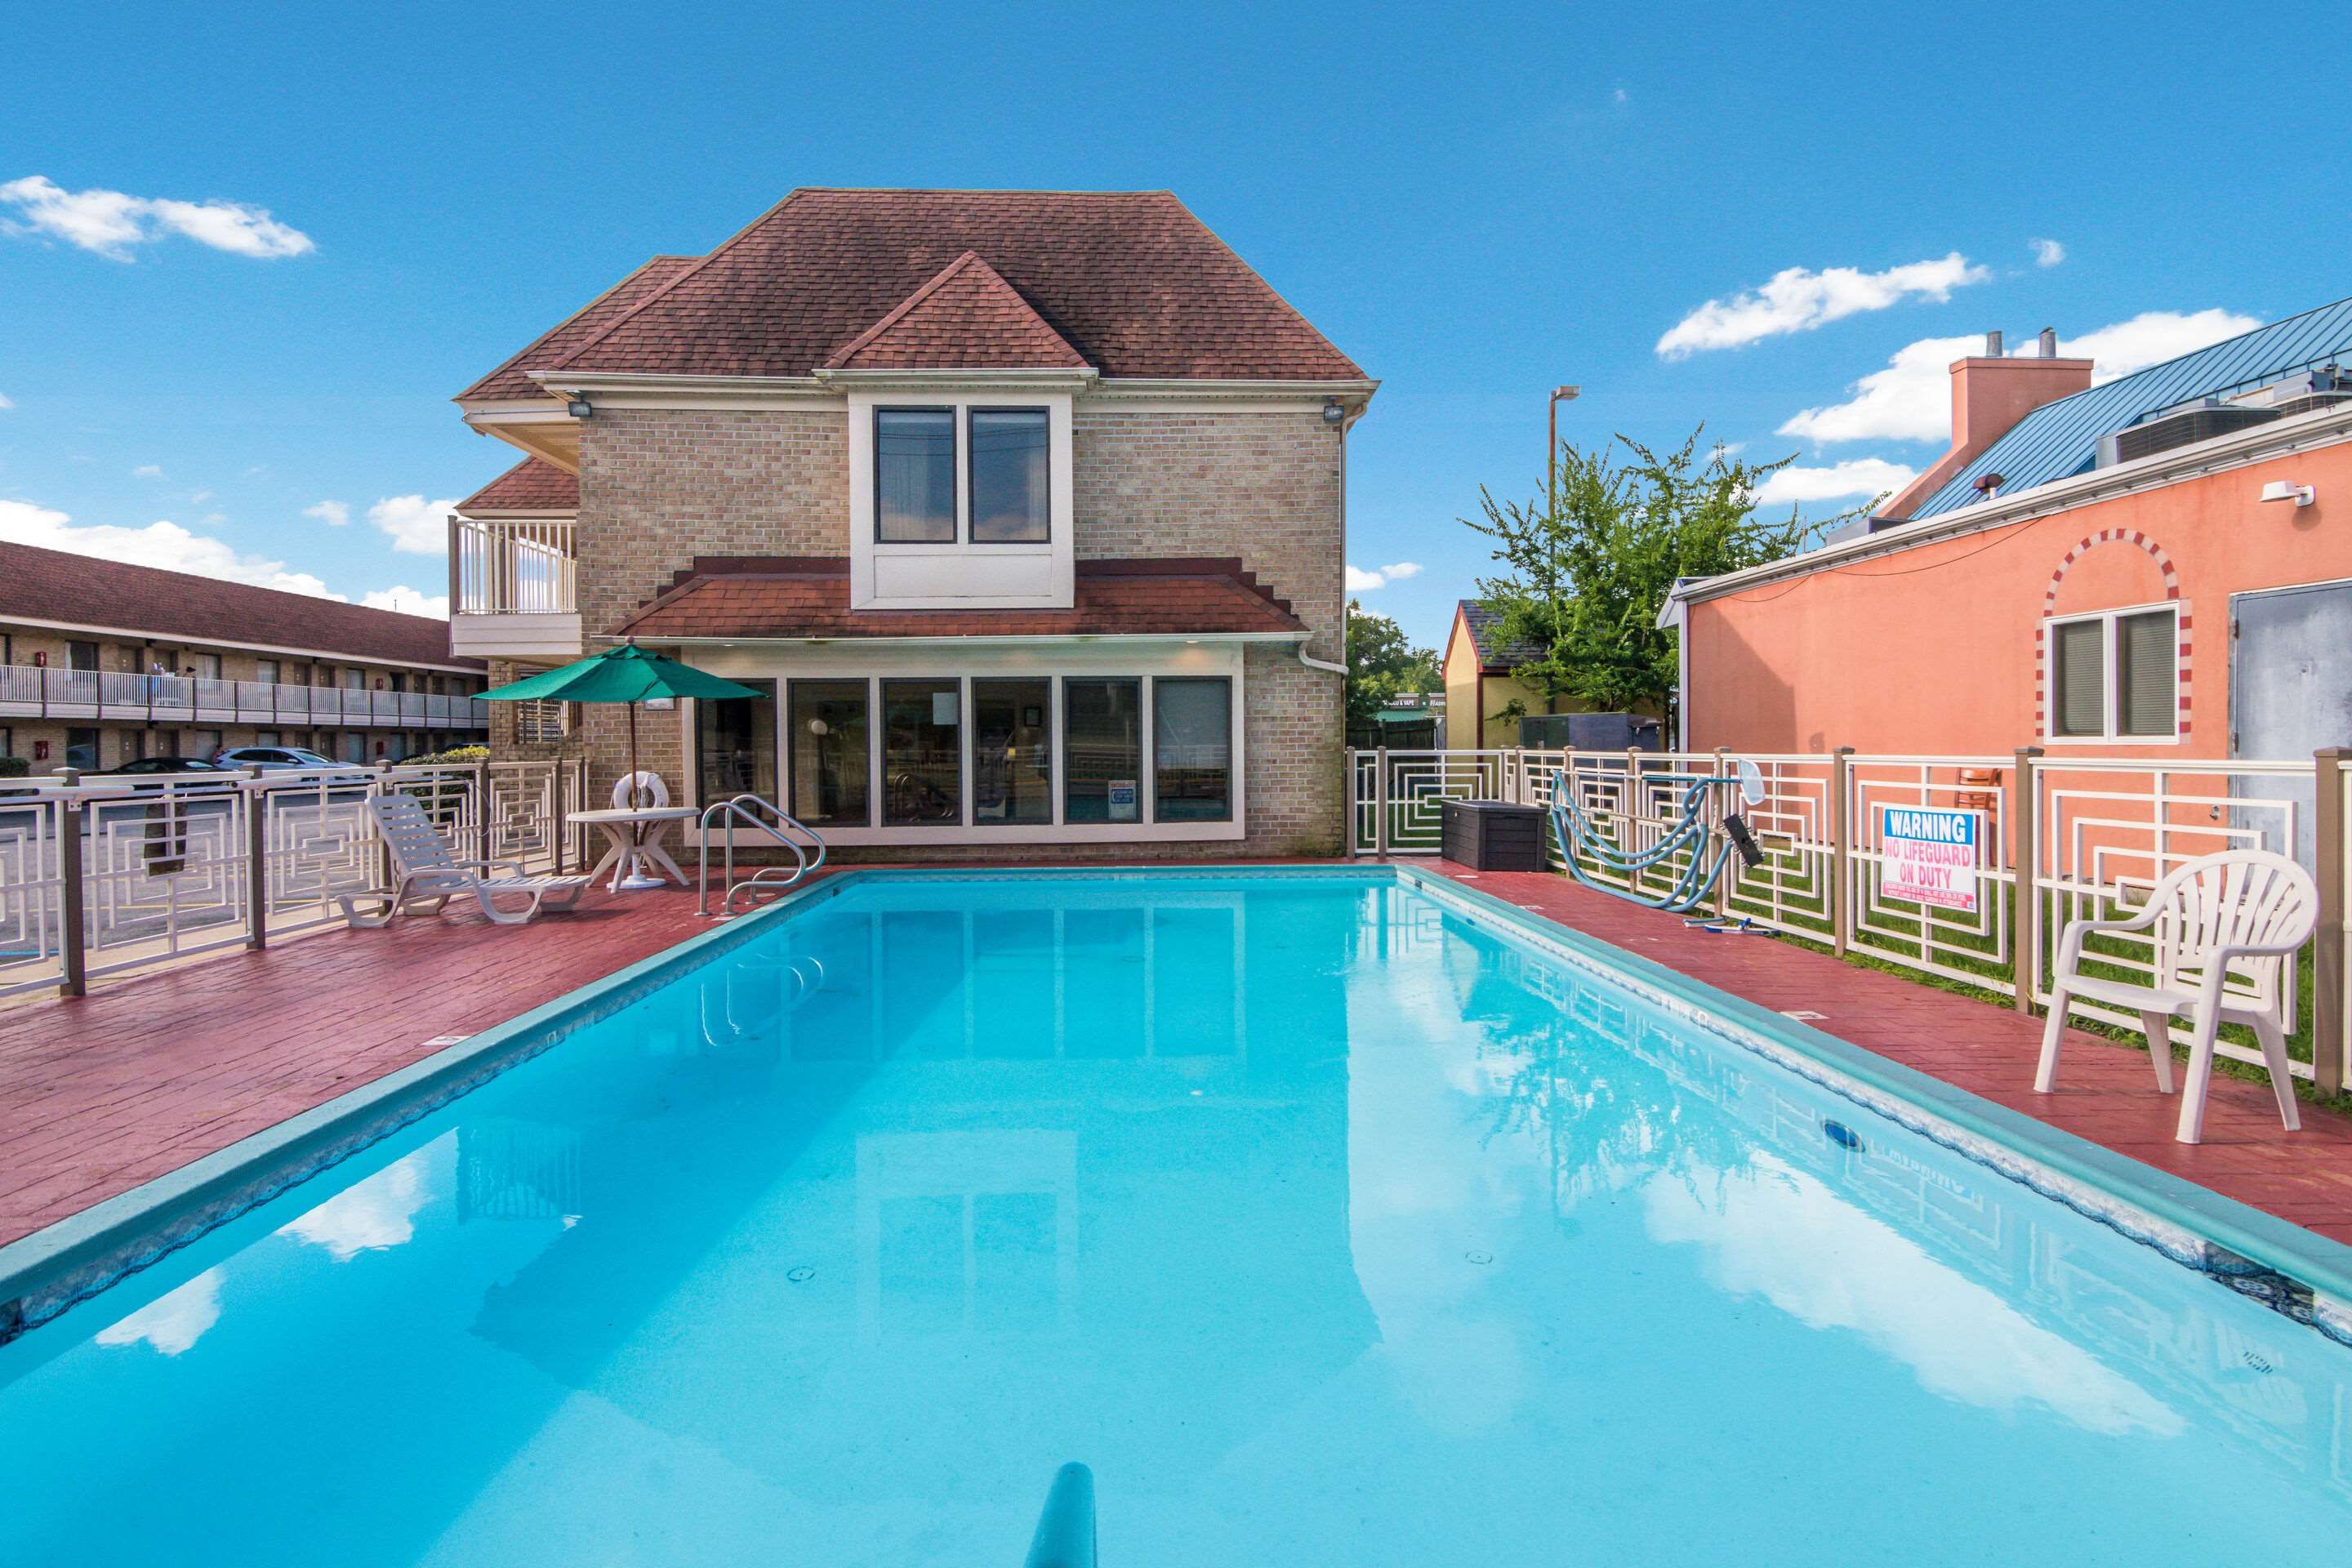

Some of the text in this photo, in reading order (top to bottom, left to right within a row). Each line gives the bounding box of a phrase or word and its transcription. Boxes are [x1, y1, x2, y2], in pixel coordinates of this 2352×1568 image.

[1889, 810, 1967, 843] WARNING
[1885, 838, 1971, 867] NO LIFEGUARD
[1900, 862, 1952, 889] ON DUTY
